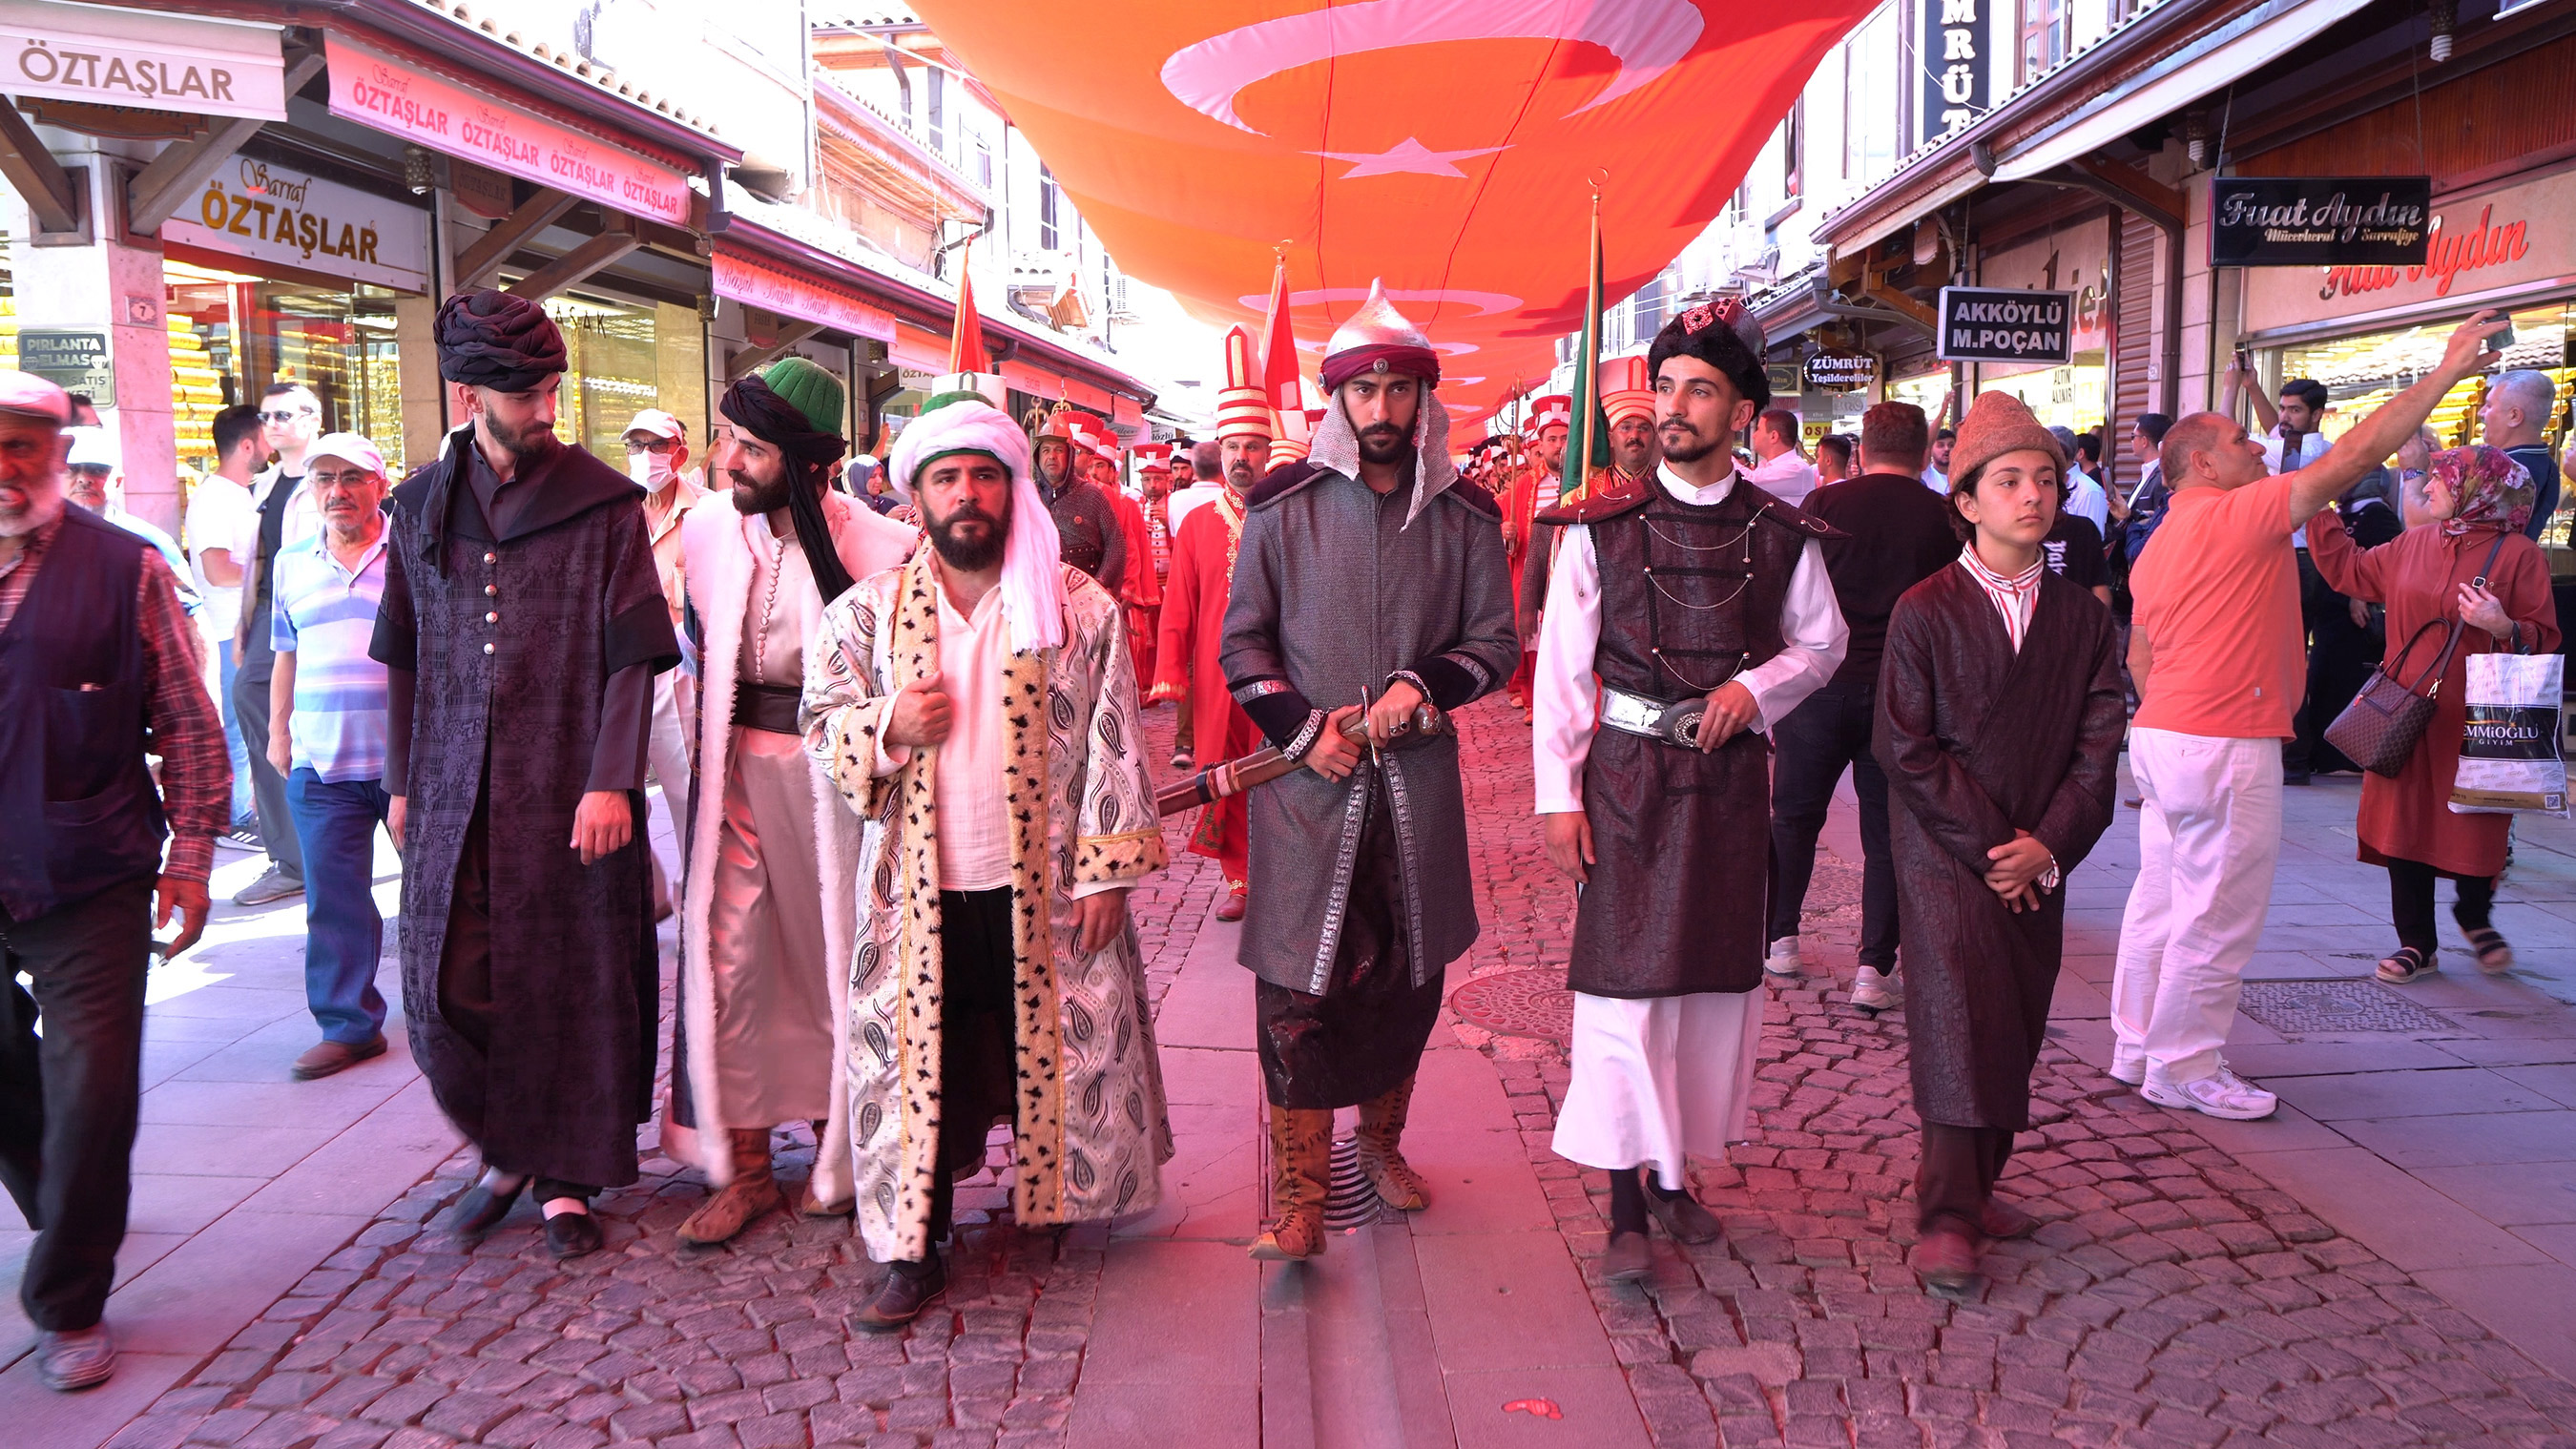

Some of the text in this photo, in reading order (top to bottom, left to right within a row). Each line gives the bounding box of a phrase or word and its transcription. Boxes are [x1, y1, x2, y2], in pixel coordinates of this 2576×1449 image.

[19, 39, 234, 101] ÖZTAŞLAR
[353, 76, 447, 135] ÖZTAŞLAR
[462, 117, 539, 167] ÖZTAŞLAR
[240, 158, 312, 213] Sarraf
[551, 150, 614, 193] ÖZTAŞLAR
[623, 176, 677, 215] ÖZTAŞLAR
[201, 179, 379, 264] ÖZTAŞLAR
[2219, 191, 2423, 244] Fuat Aydın
[139, 306, 146, 317] 7
[1954, 300, 2063, 325] AKKÖYLÜ
[27, 338, 102, 351] PIRLANTA
[1952, 328, 2062, 355] M.POÇAN
[40, 354, 91, 366] ELMAS
[1812, 355, 1873, 369] ZÜMRÜT
[71, 376, 106, 388] SATIŞ
[1812, 373, 1874, 383] Yeşildereliler
